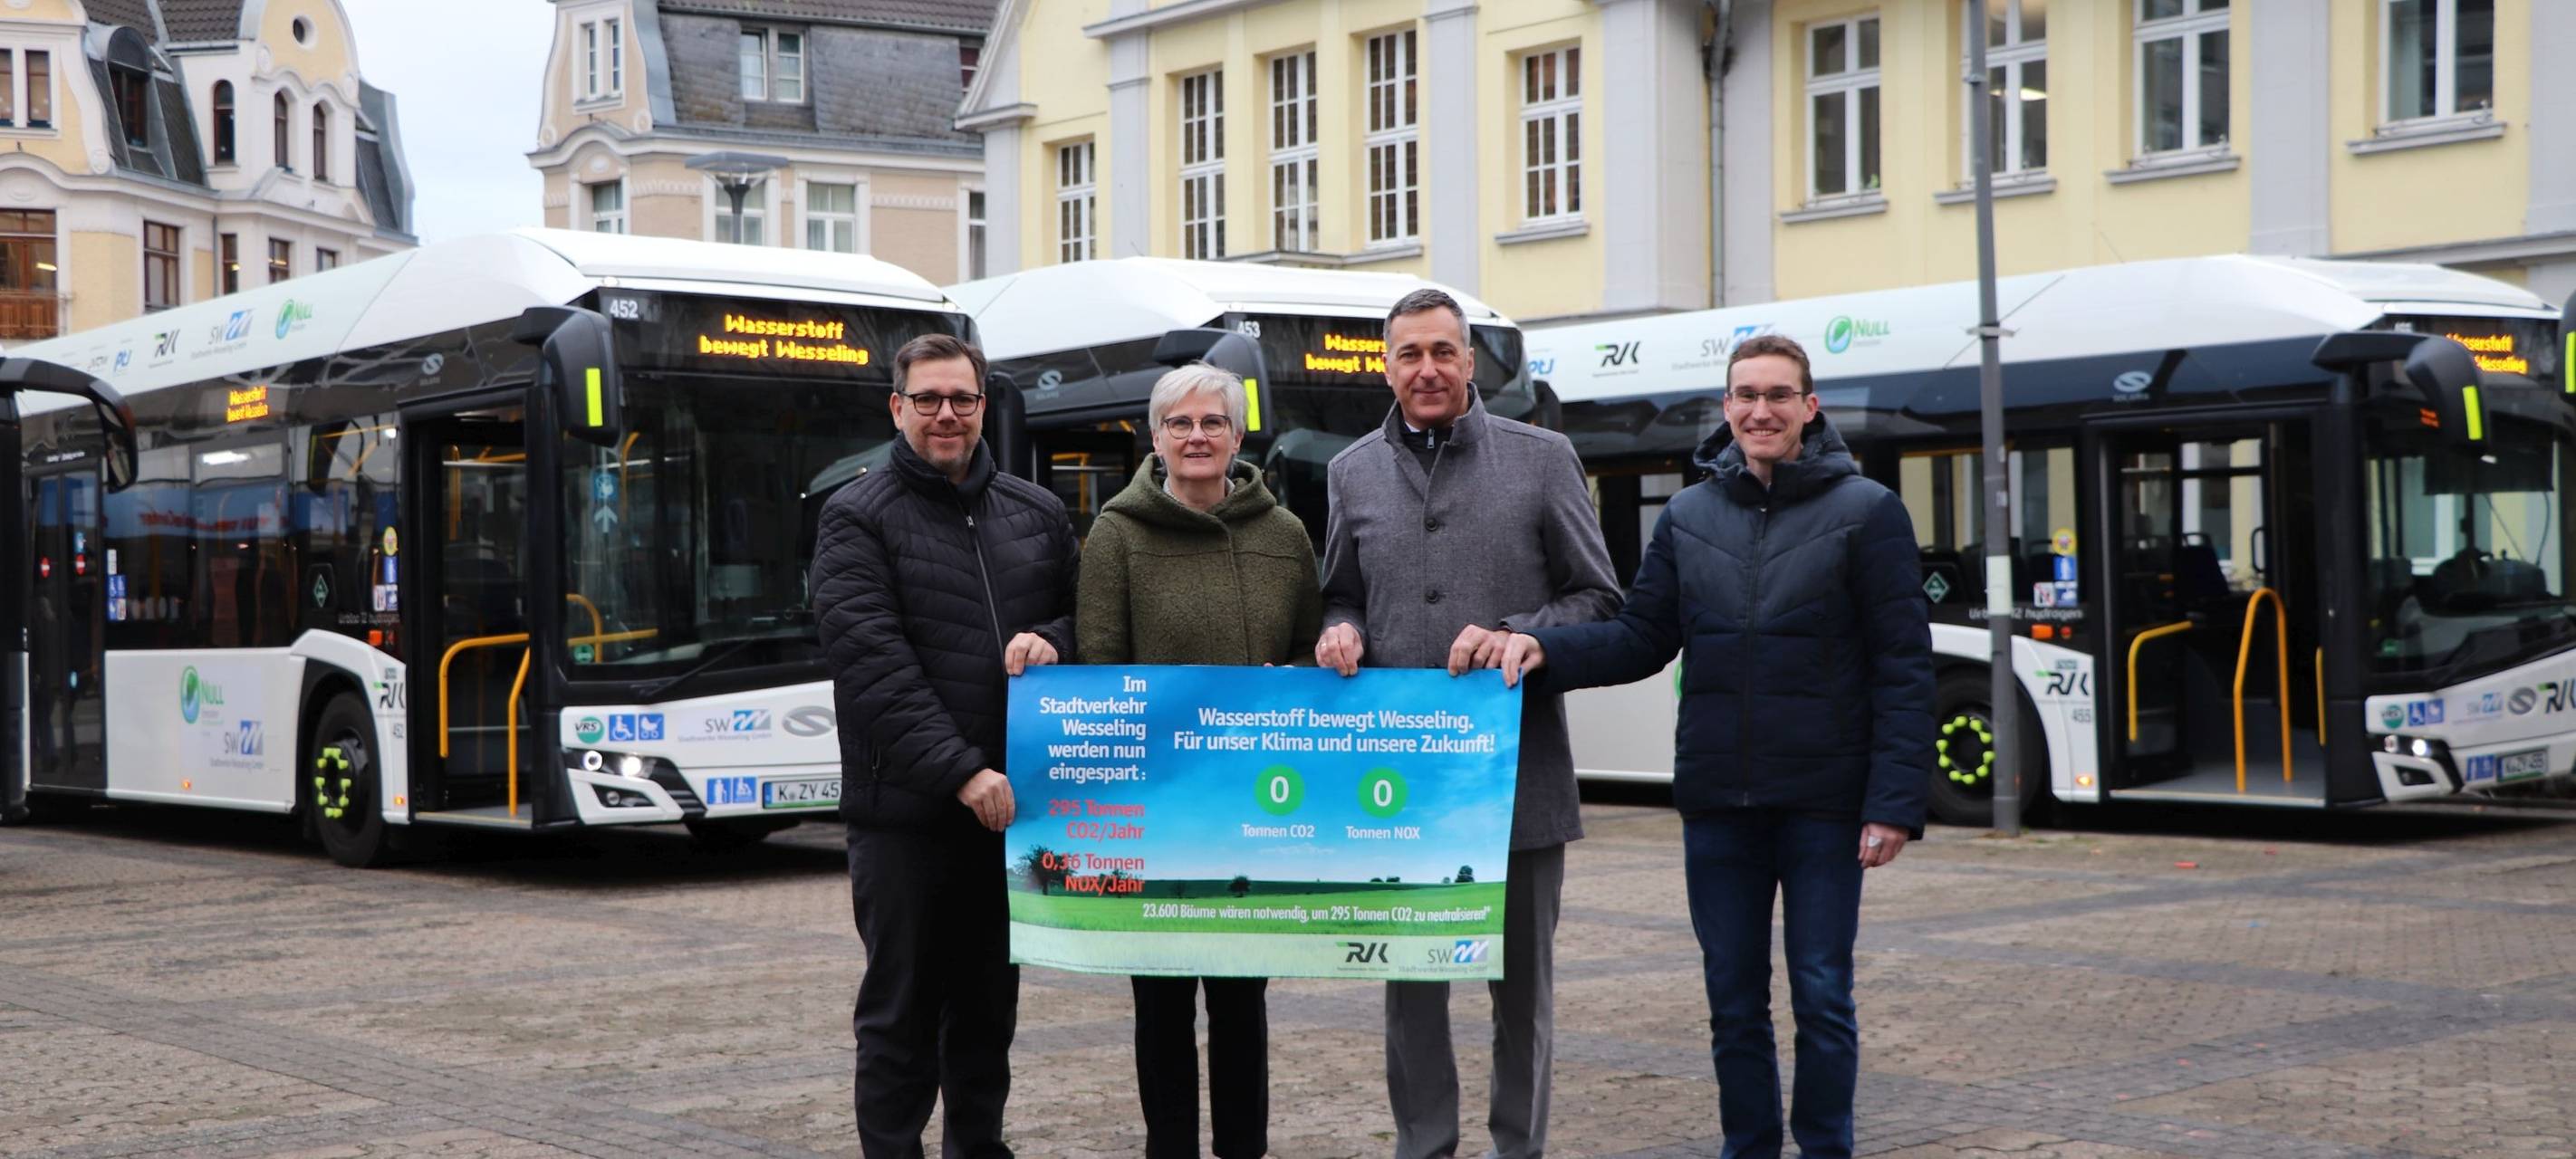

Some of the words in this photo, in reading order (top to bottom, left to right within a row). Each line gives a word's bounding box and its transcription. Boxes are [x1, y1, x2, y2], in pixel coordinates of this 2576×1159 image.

[610, 300, 639, 319] 452
[725, 314, 844, 340] Wasserstoff
[1237, 321, 1260, 338] 453
[698, 335, 769, 359] bewegt
[776, 340, 869, 365] Wesseling
[1324, 334, 1387, 353] Wassers
[1305, 353, 1360, 372] bewegt
[2025, 608, 2083, 620] hydrogen
[1123, 675, 1147, 693] Im
[1040, 696, 1147, 714] Stadtverkehr
[1062, 719, 1147, 741] Wesseling
[1198, 707, 1305, 727] Wasserstoff
[1308, 710, 1375, 733] bewegt
[1379, 711, 1475, 734] Wesseling.
[1048, 741, 1110, 759] werden
[1113, 745, 1146, 759] nun
[1173, 731, 1203, 751] Für
[1206, 734, 1256, 751] unser
[1262, 733, 1312, 752] Klima
[1318, 734, 1351, 752] und
[1357, 736, 1417, 753] unsere
[1420, 734, 1495, 753] Zukunft!
[779, 785, 789, 800] K
[799, 784, 818, 800] ZY
[822, 782, 840, 798] 45
[1270, 776, 1290, 803] 0
[1373, 780, 1393, 807] 0
[1049, 799, 1081, 816] 295
[1084, 800, 1145, 817] Tonnen
[1066, 821, 1145, 843] CO2/Jahr
[1242, 824, 1287, 838] Tonnen
[1290, 825, 1315, 838] CO2
[1346, 826, 1391, 839] Tonnen
[1394, 827, 1421, 839] NOX
[1042, 852, 1081, 870] 0,36
[1084, 853, 1145, 870] Tonnen
[1065, 874, 1145, 896] NOX/Jahr
[1143, 903, 1177, 918] 23.600
[1180, 904, 1216, 919] Bäume
[1220, 905, 1251, 919] wären
[1253, 905, 1310, 924] notwendig,
[1312, 909, 1328, 920] um
[1331, 906, 1350, 920] 295
[1352, 906, 1389, 921] Tonnen
[1391, 907, 1413, 921] CO2
[1414, 911, 1426, 921] zu
